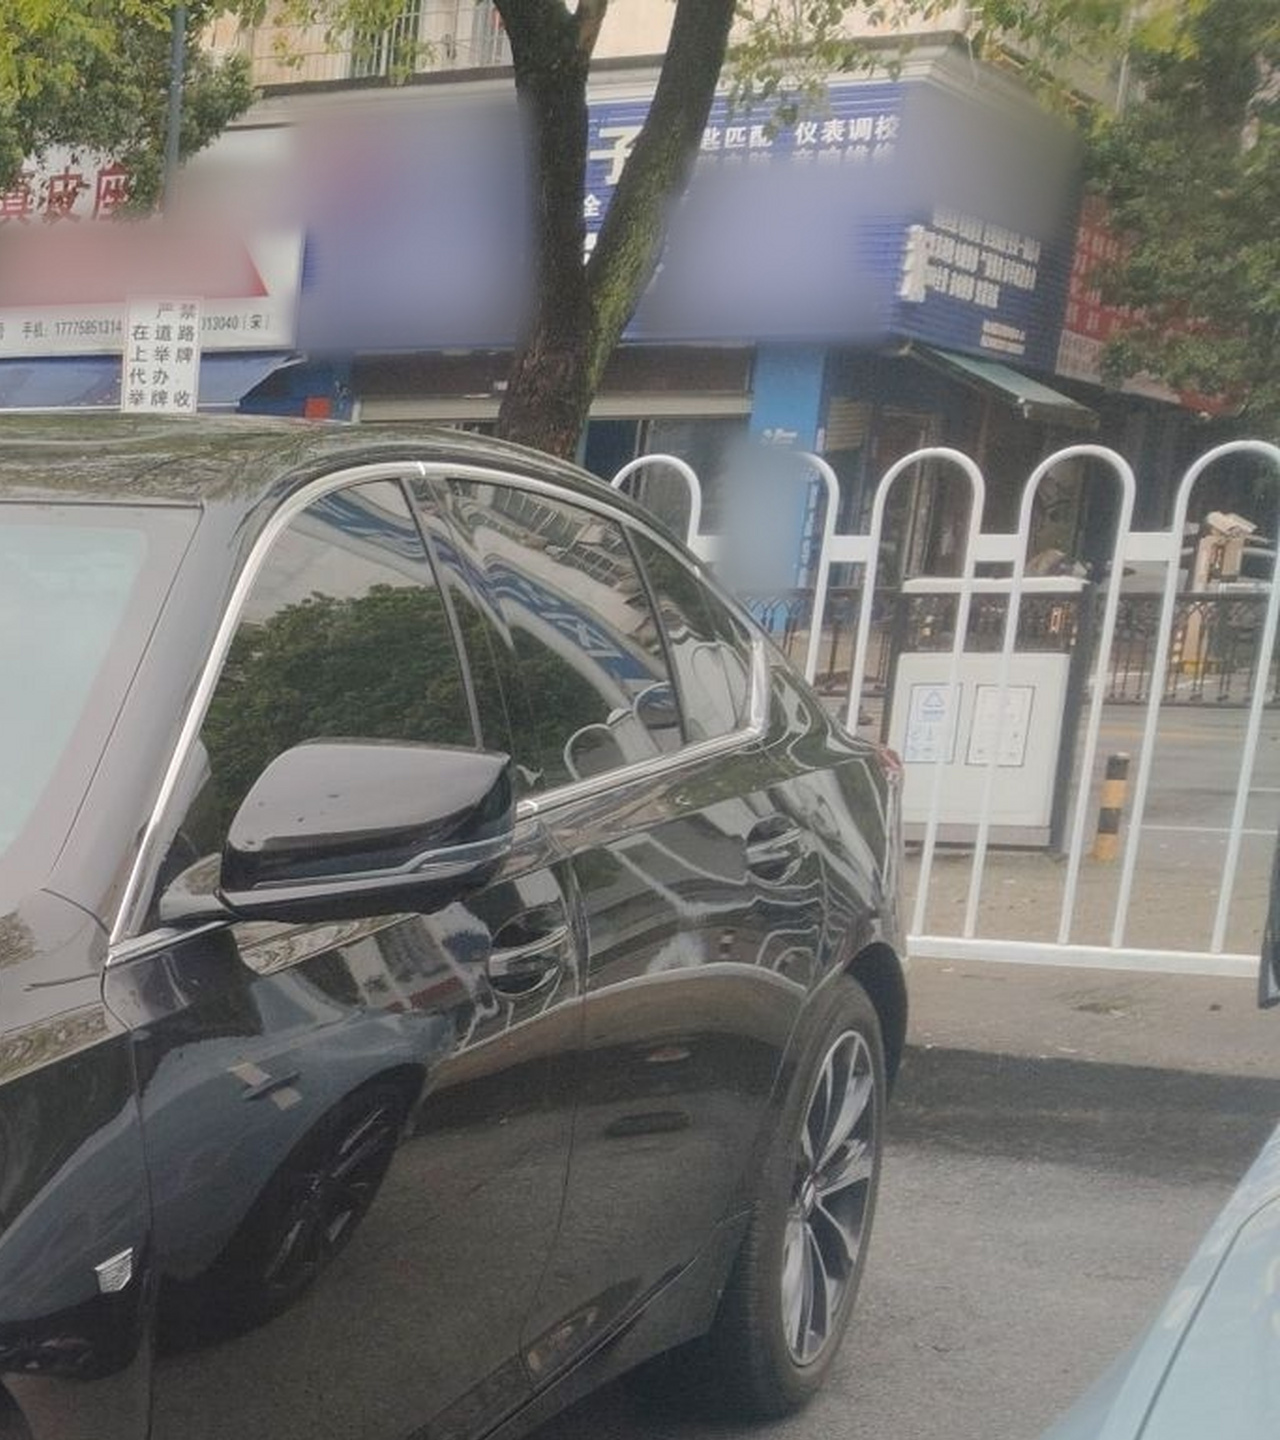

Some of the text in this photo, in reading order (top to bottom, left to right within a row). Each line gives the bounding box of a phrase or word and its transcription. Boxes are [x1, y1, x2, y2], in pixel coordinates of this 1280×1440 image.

[794, 116, 900, 145] 仪表调校
[157, 302, 196, 320] 严禁
[131, 324, 195, 342] 在道路
[129, 346, 194, 364] 上举牌
[129, 367, 170, 386] 代办
[128, 389, 192, 409] 举牌收
